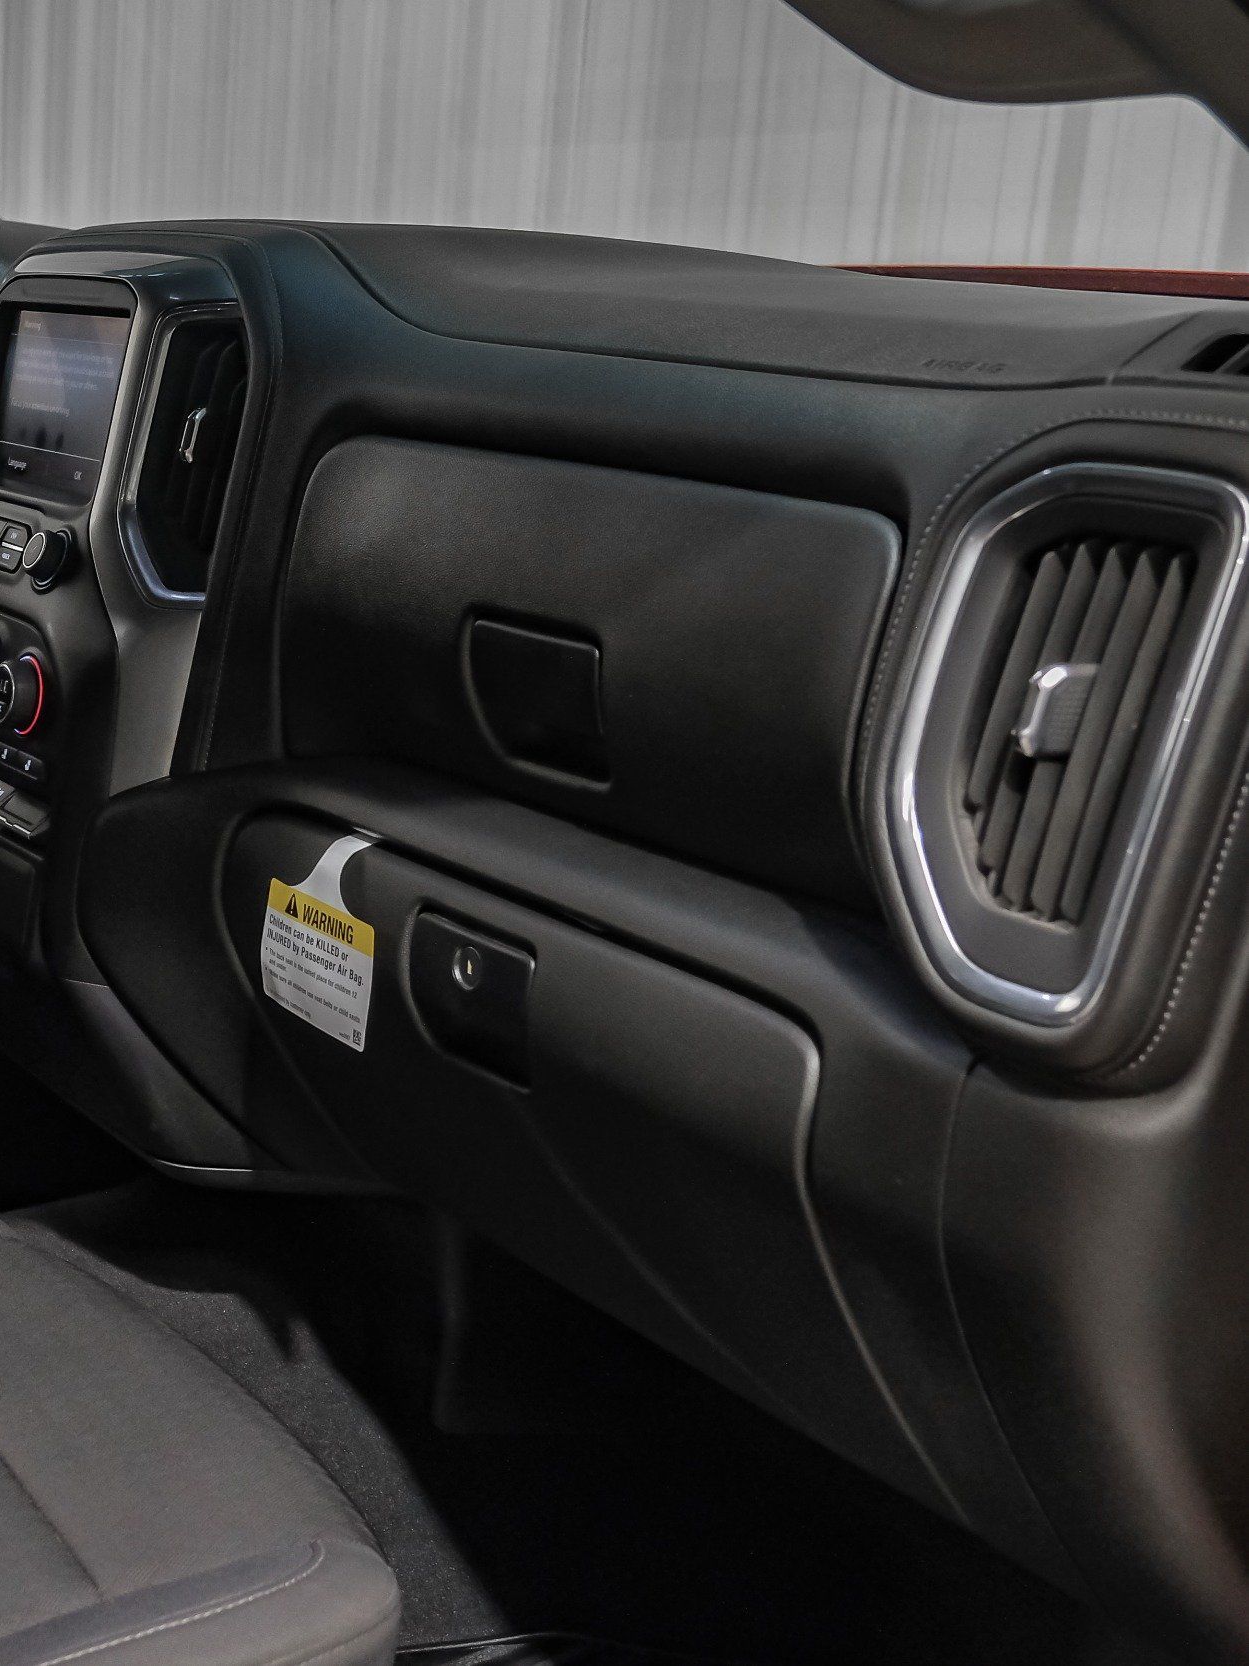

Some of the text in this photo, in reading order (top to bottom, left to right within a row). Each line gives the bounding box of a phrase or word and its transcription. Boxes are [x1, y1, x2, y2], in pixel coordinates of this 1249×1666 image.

[269, 913, 348, 962] Children can be KILLED or
[303, 903, 354, 945] WARNING
[267, 927, 364, 988] INJURED by Passenger Air Bag.
